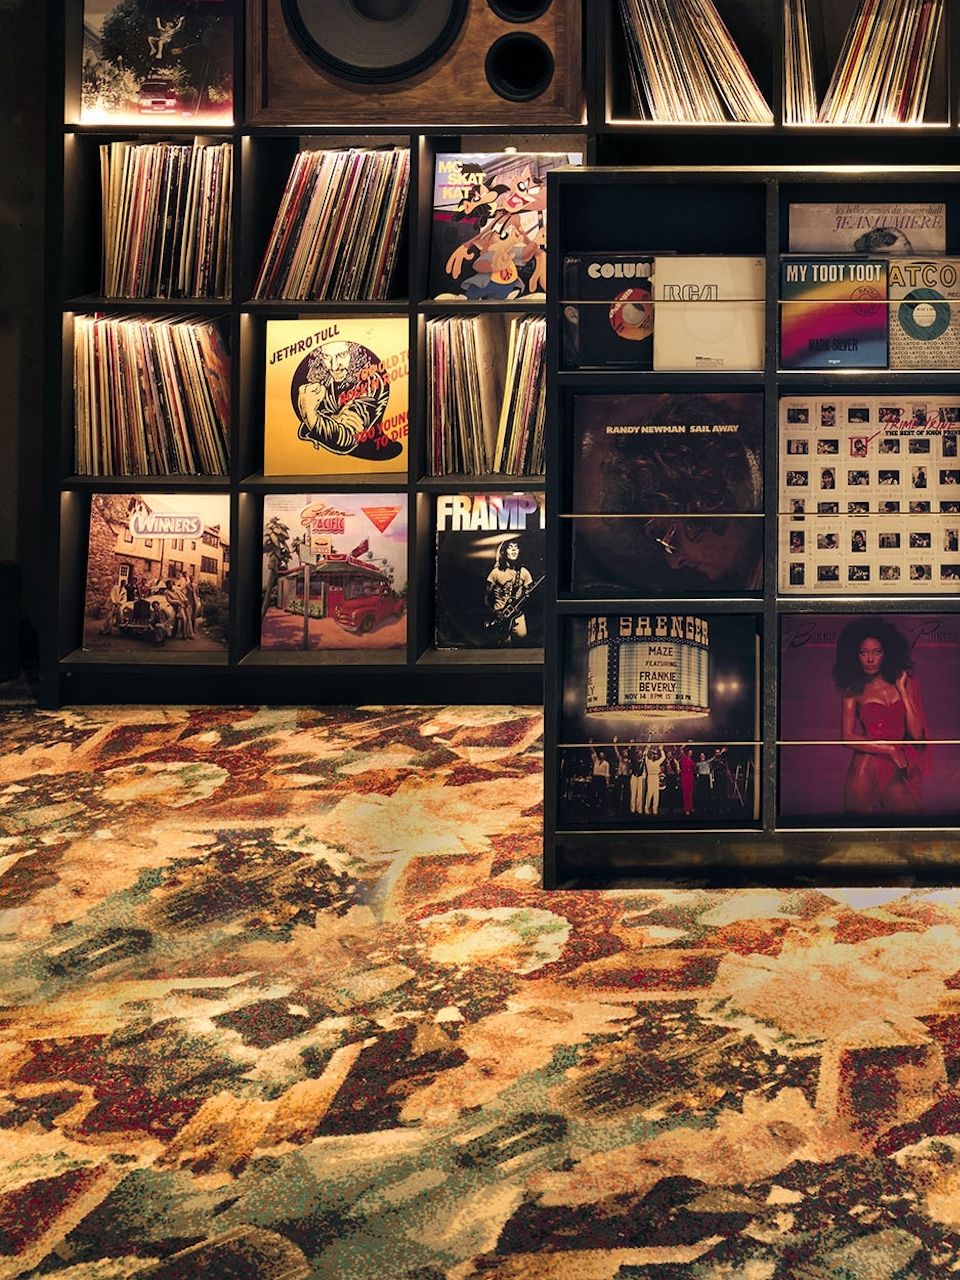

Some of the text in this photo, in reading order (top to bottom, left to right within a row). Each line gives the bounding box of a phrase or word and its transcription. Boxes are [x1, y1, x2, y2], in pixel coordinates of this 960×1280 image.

[438, 161, 462, 173] MC
[447, 172, 487, 185] SKAT
[442, 187, 473, 199] KAT
[588, 263, 653, 279] COLUM
[786, 263, 882, 282] MY TOOT TOOT
[889, 265, 957, 288] ATCO
[664, 285, 718, 301] RCA
[270, 324, 340, 365] JETHRO TULL
[809, 339, 858, 352] MARK SILVER
[378, 355, 400, 372] OLD
[338, 382, 369, 405] ROCK
[377, 412, 409, 434] YOUN
[606, 424, 739, 434] RANDY NEWMAN SAIL AWAY
[374, 424, 409, 450] TO DIE
[136, 512, 198, 533] WINNERS
[300, 503, 356, 526] Southern
[312, 517, 345, 529] PACIFIC
[619, 615, 709, 646] SAENGER
[648, 647, 673, 656] MAZE
[639, 672, 677, 681] FRANKIE
[639, 682, 676, 692] BEVERLY
